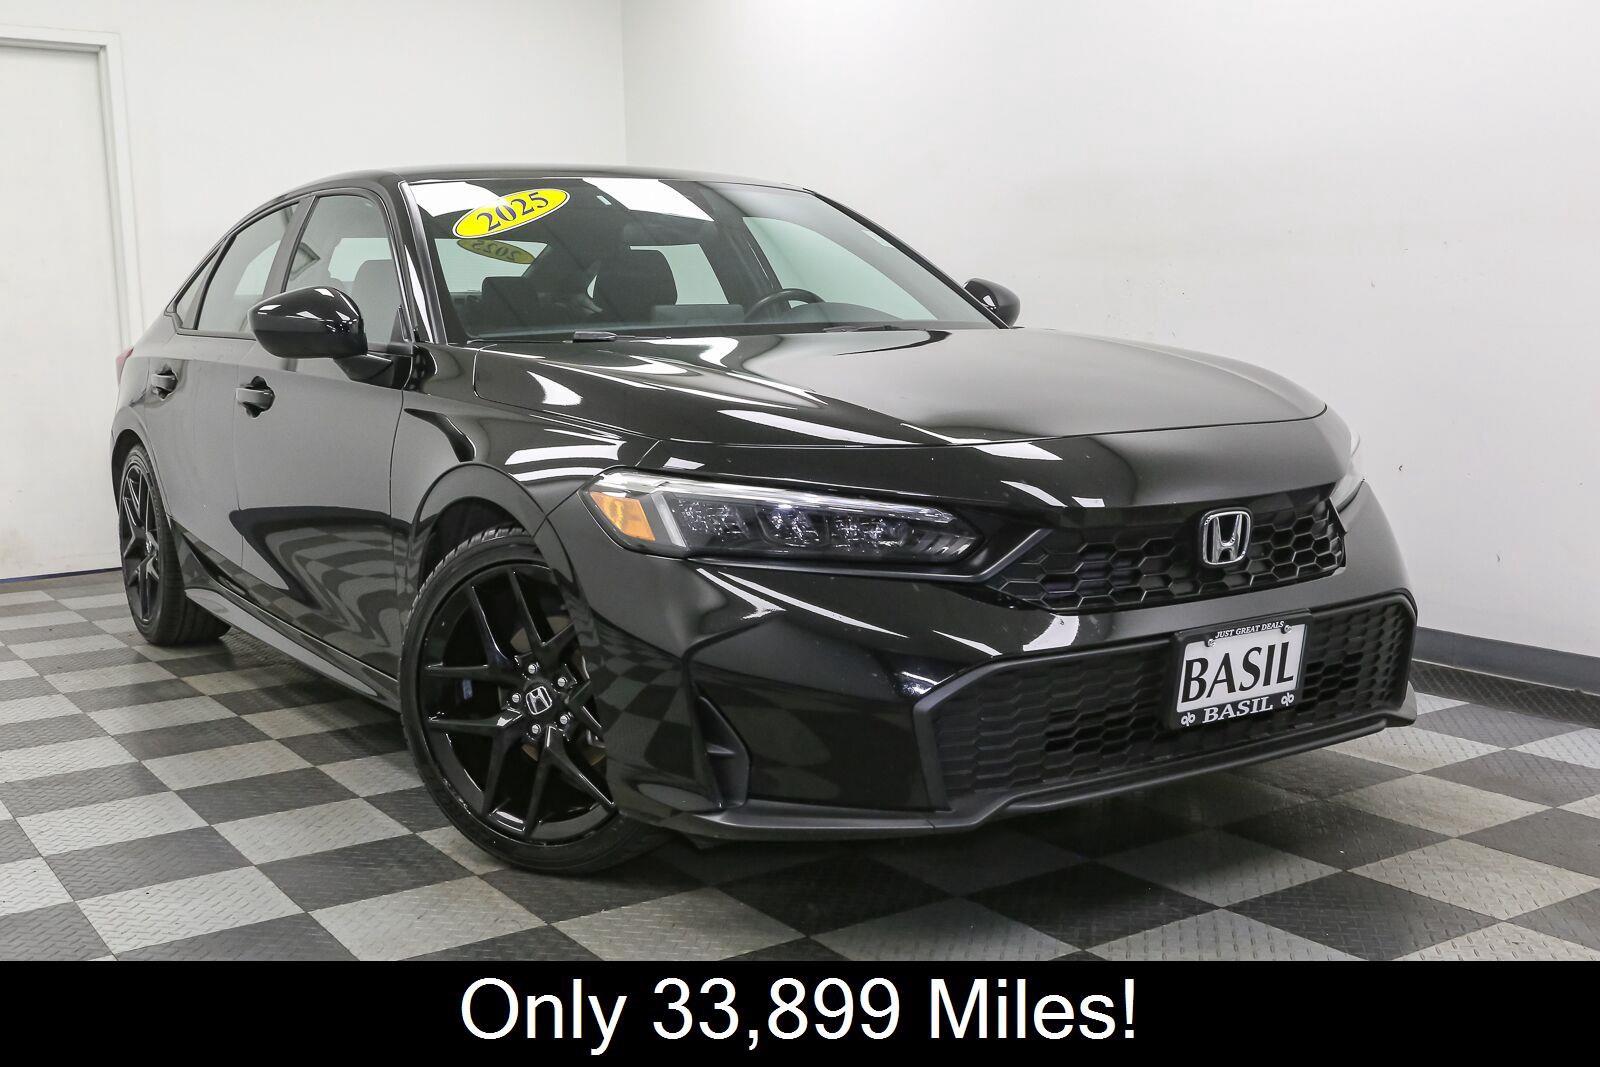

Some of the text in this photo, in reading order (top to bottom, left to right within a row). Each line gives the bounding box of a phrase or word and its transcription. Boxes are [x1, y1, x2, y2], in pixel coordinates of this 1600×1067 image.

[477, 191, 549, 231] 2025
[1215, 620, 1285, 639] JUST GREAT DEALS
[1181, 641, 1294, 703] BASIL
[1202, 696, 1274, 724] BASIL
